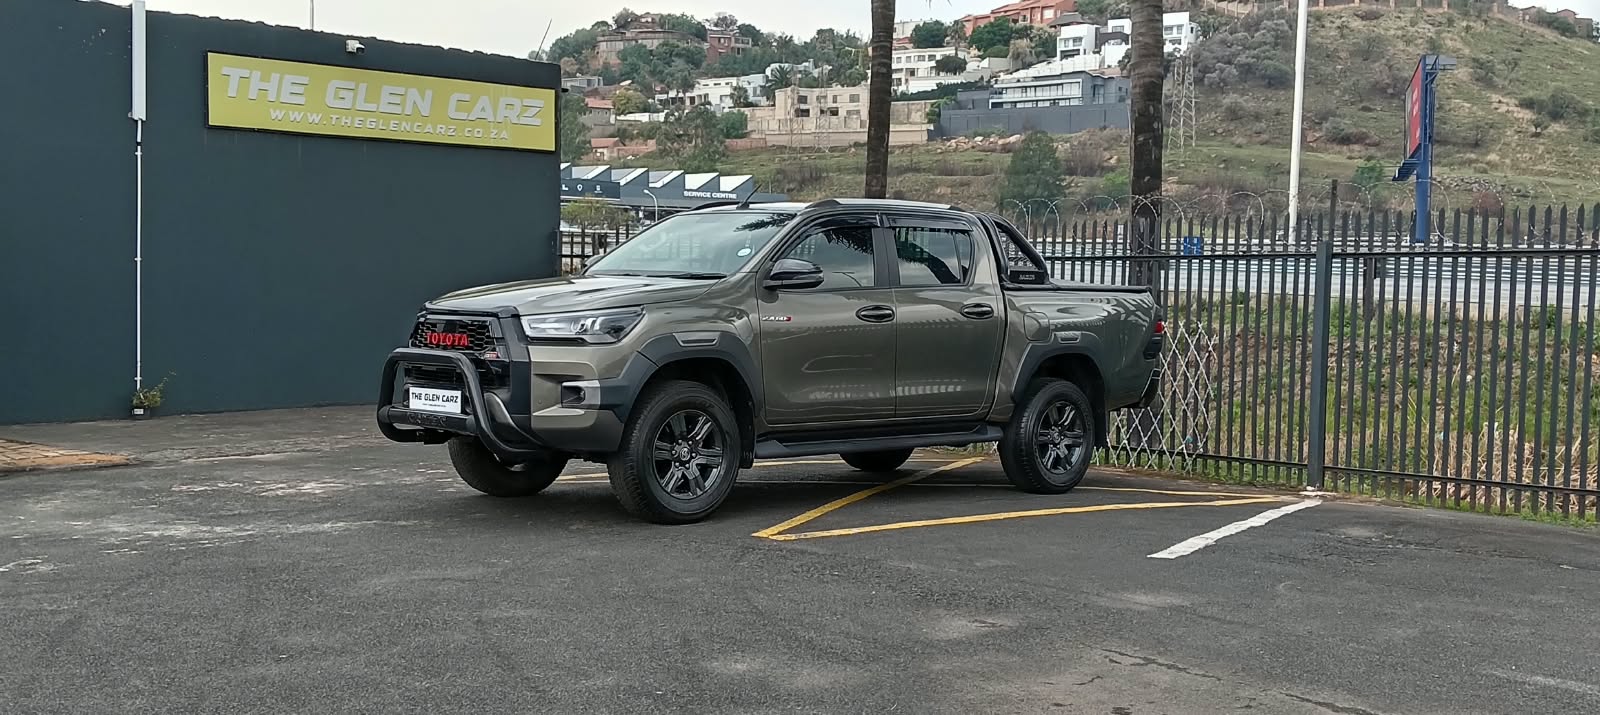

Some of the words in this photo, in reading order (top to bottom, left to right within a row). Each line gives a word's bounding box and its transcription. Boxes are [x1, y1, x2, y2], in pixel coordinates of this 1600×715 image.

[221, 66, 309, 105] THE
[325, 79, 433, 117] GLEN
[447, 92, 546, 126] CARZ
[269, 108, 509, 140] WWW.THEGLENCARZ.CO.ZA
[426, 332, 468, 346] TOYOTA
[411, 392, 423, 401] THE
[424, 393, 440, 402] GLEN
[441, 394, 459, 403] CARZ
